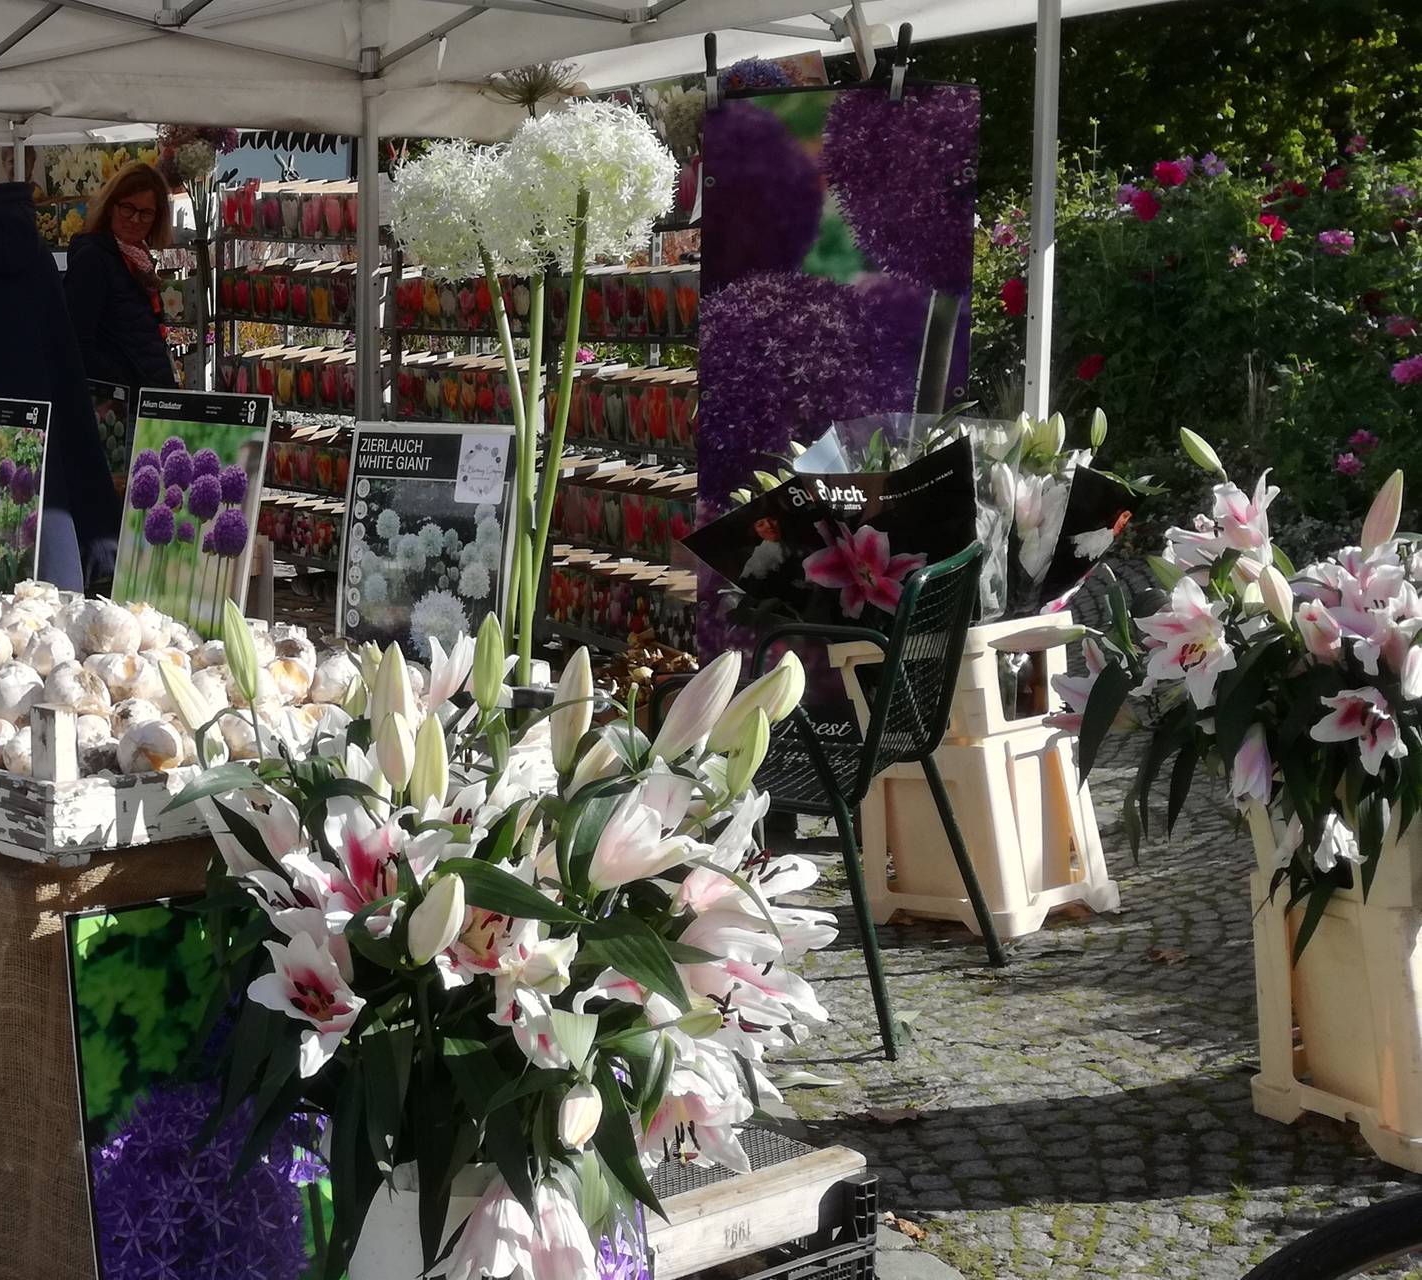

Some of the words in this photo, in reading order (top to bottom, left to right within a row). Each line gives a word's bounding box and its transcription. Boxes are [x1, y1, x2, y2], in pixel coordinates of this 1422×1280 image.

[142, 400, 157, 408] Allium
[158, 401, 182, 410] Gladiator
[360, 438, 423, 454] ZIERLAUCH
[358, 455, 395, 470] WHITE
[396, 456, 432, 471] GIANT
